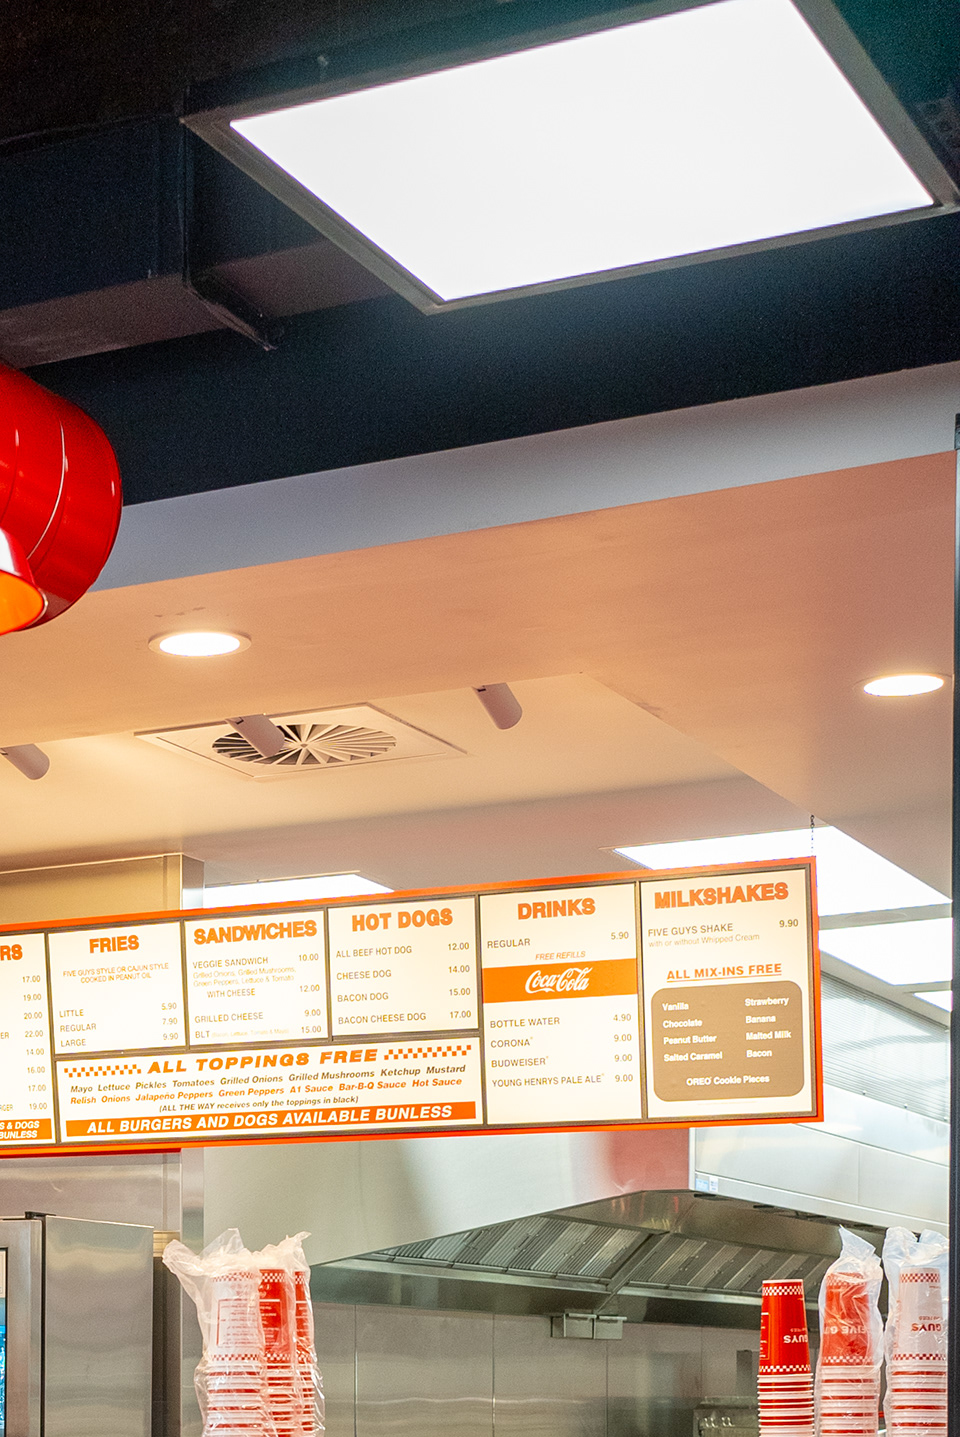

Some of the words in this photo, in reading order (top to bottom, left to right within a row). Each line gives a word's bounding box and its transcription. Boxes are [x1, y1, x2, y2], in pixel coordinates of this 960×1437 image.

[654, 882, 789, 909] MILKSHAKES
[517, 898, 596, 920] DRINKS
[351, 912, 392, 932] HOT
[397, 907, 453, 929] DOGS
[193, 919, 317, 945] SANDWICHES
[648, 928, 668, 937] FIVE
[671, 926, 698, 935] GUYS
[700, 923, 734, 933] SHAKE
[779, 918, 799, 928] 9.90
[89, 934, 140, 954] FRIES
[487, 938, 531, 949] REGULAR
[610, 931, 629, 940] 5.90
[336, 950, 351, 958] ALL
[352, 948, 374, 957] BEEF
[375, 946, 392, 956] HOT
[394, 945, 413, 954] DOG
[447, 942, 470, 951] 12.00
[535, 952, 555, 961] FREE
[556, 950, 586, 959] REFILLS
[192, 960, 223, 969] VEGGIE
[224, 956, 269, 967] SANDWICH
[298, 953, 319, 962] 10.00
[22, 975, 41, 983] 17.00
[336, 970, 370, 980] CHEESE
[372, 969, 392, 978] DOG
[448, 964, 470, 973] 14.00
[667, 970, 690, 980] ALL
[694, 965, 744, 978] MIX-INS
[748, 963, 782, 975] FREE
[525, 966, 594, 993] Coca-Cola
[23, 993, 42, 1001] 19.00
[206, 989, 225, 998] WITH
[226, 988, 256, 997] CHEESE
[299, 984, 320, 993] 12.00
[337, 993, 368, 1002] BACON
[369, 991, 389, 1001] DOG
[449, 987, 471, 996] 15.00
[662, 1002, 689, 1011] Vanilla
[744, 996, 790, 1007] Strawberry
[59, 1009, 84, 1018] LITTLE
[161, 1002, 177, 1010] 5.90
[194, 1013, 229, 1023] GRILLED
[231, 1011, 264, 1021] CHEESE
[304, 1009, 321, 1017] 9.00
[338, 1015, 368, 1025] BACON
[370, 1013, 405, 1023] CHEESE
[407, 1012, 427, 1021] DOG
[449, 1010, 472, 1019] 17.00
[60, 1023, 97, 1032] REGULAR
[162, 1017, 178, 1025] 7.90
[490, 1018, 525, 1029] BOTTLE
[528, 1016, 560, 1026] WATER
[613, 1013, 631, 1022] 4.90
[662, 1018, 703, 1028] Chocolate
[745, 1014, 776, 1024] Banana
[60, 1038, 86, 1047] LARGE
[163, 1032, 179, 1040] 9.90
[195, 1030, 210, 1039] BLT
[301, 1025, 322, 1034] 15.00
[613, 1033, 632, 1042] 9.00
[663, 1036, 691, 1045] Peanut
[692, 1034, 717, 1043] Butter
[745, 1031, 773, 1041] Malted
[774, 1030, 792, 1039] Milk
[147, 1060, 188, 1074] ALL
[195, 1052, 310, 1071] TOPPINGS
[319, 1048, 378, 1064] FREE
[614, 1053, 633, 1062] 9.00
[663, 1053, 689, 1062] Salted
[690, 1051, 723, 1061] Caramel
[746, 1049, 773, 1058] Bacon
[70, 1085, 93, 1094] Mayo
[97, 1082, 131, 1092] Lettuce
[135, 1080, 167, 1090] Pickles
[172, 1078, 215, 1088] Tomatoes
[220, 1075, 250, 1086] Grilled
[252, 1074, 284, 1084] Onions
[288, 1072, 320, 1082] Grilled
[321, 1069, 375, 1080] Mushrooms
[380, 1067, 421, 1077] Ketchup
[425, 1064, 466, 1074] Mustard
[492, 1078, 522, 1088] YOUNG
[524, 1076, 559, 1086] HENRYS
[561, 1075, 583, 1084] PALE
[614, 1073, 634, 1083] 9.00
[713, 1075, 742, 1085] Cookie
[743, 1074, 770, 1083] Pieces
[70, 1096, 97, 1105] Relish
[101, 1094, 131, 1103] Onions
[177, 1090, 214, 1100] Peppers
[218, 1089, 245, 1097] Green
[247, 1086, 285, 1097] Peppers
[290, 1085, 302, 1094] A1
[304, 1084, 334, 1093] Sauce
[339, 1081, 375, 1091] Bar-B-Q
[377, 1080, 407, 1089] Sauce
[412, 1078, 429, 1087] Hot
[431, 1077, 463, 1086] Sauce
[87, 1121, 115, 1134] ALL
[119, 1117, 192, 1132] BURGERS
[196, 1115, 230, 1129] AND
[233, 1112, 279, 1127] DOGS
[282, 1109, 371, 1125] AVAILABLE
[375, 1105, 453, 1121] BUNLESS
